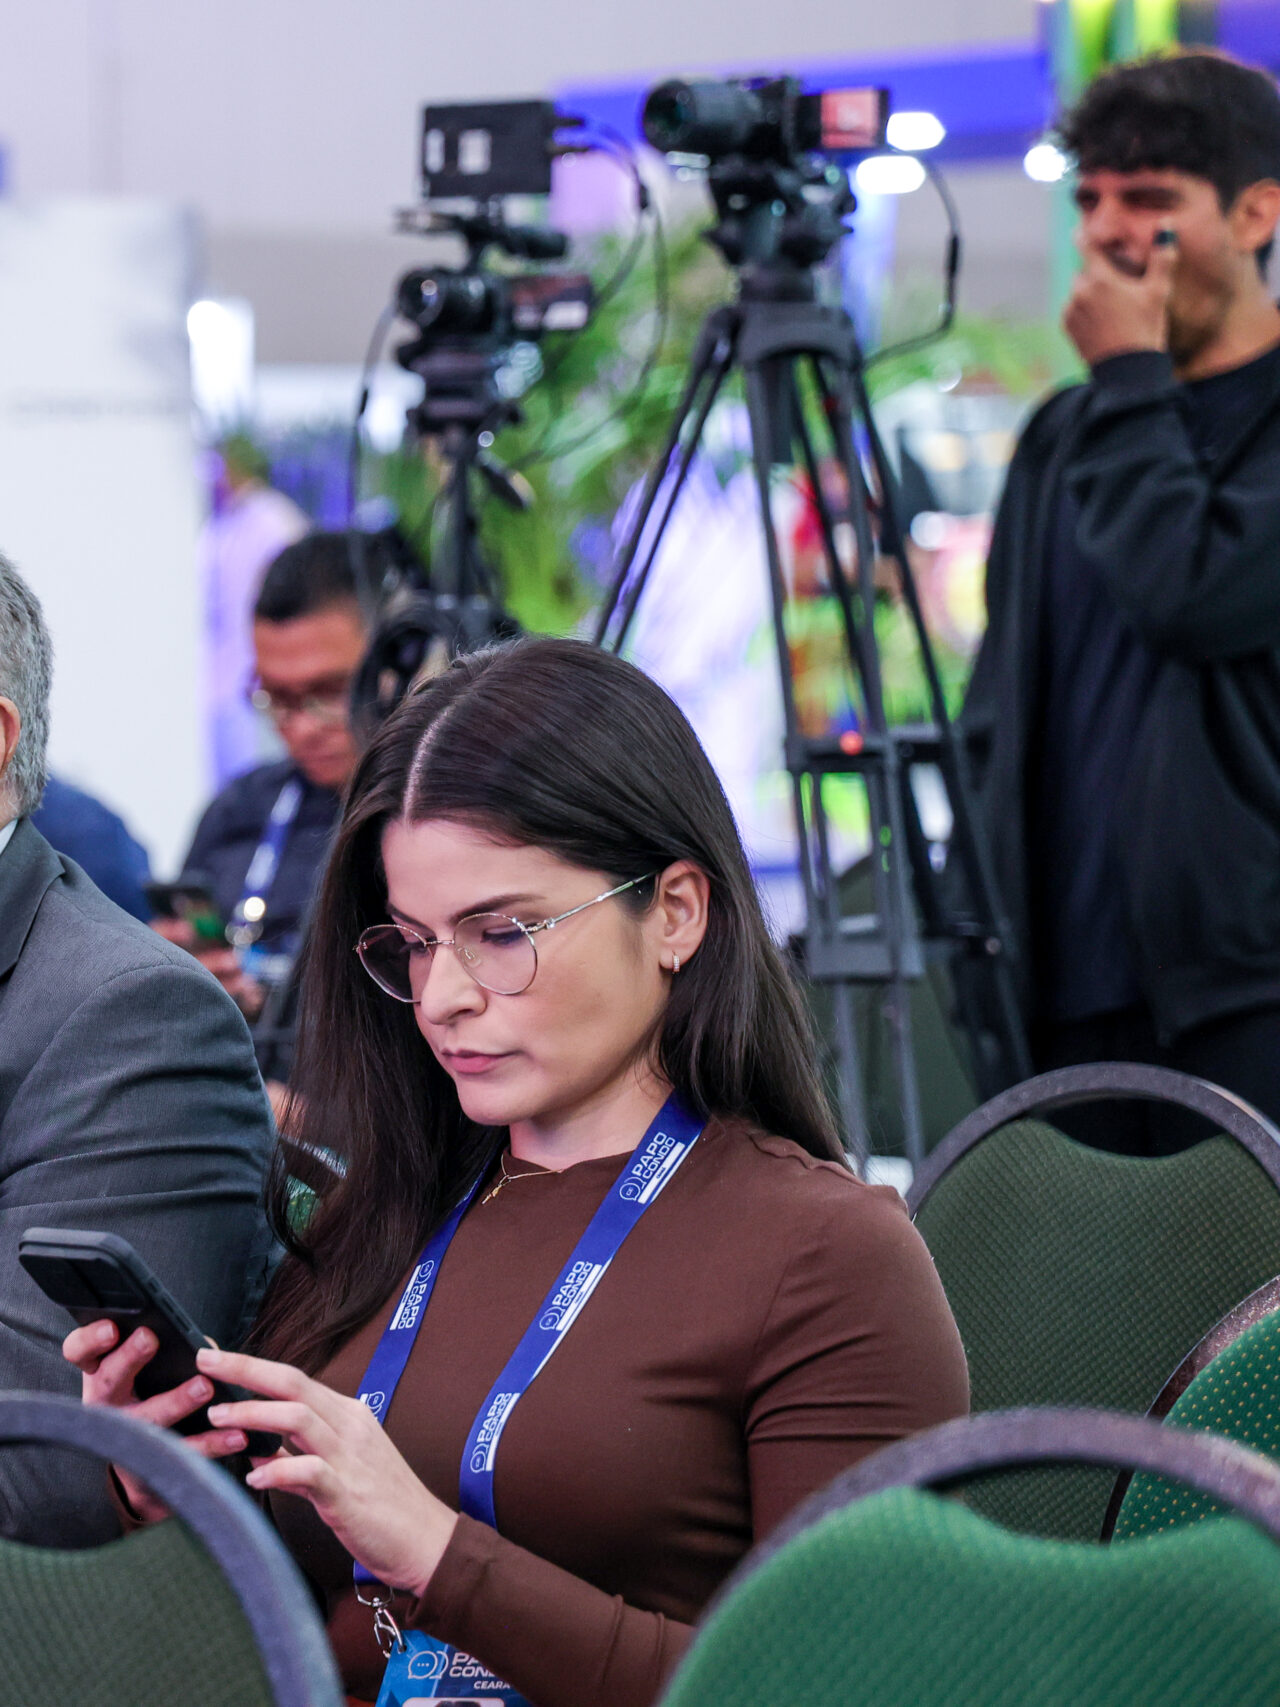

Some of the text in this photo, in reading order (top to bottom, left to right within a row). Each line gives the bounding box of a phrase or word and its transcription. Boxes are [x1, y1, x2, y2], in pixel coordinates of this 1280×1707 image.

[631, 1132, 667, 1177] PAPO
[642, 1136, 676, 1179] CONDO
[552, 1261, 585, 1305] PAPO
[561, 1262, 593, 1307] CONDO
[397, 1285, 419, 1330] CONDO
[405, 1283, 428, 1329] PAPO
[476, 1392, 505, 1443] PAPO
[485, 1392, 512, 1442] CONDO
[449, 1666, 495, 1678] CON
[452, 1652, 480, 1666] PA
